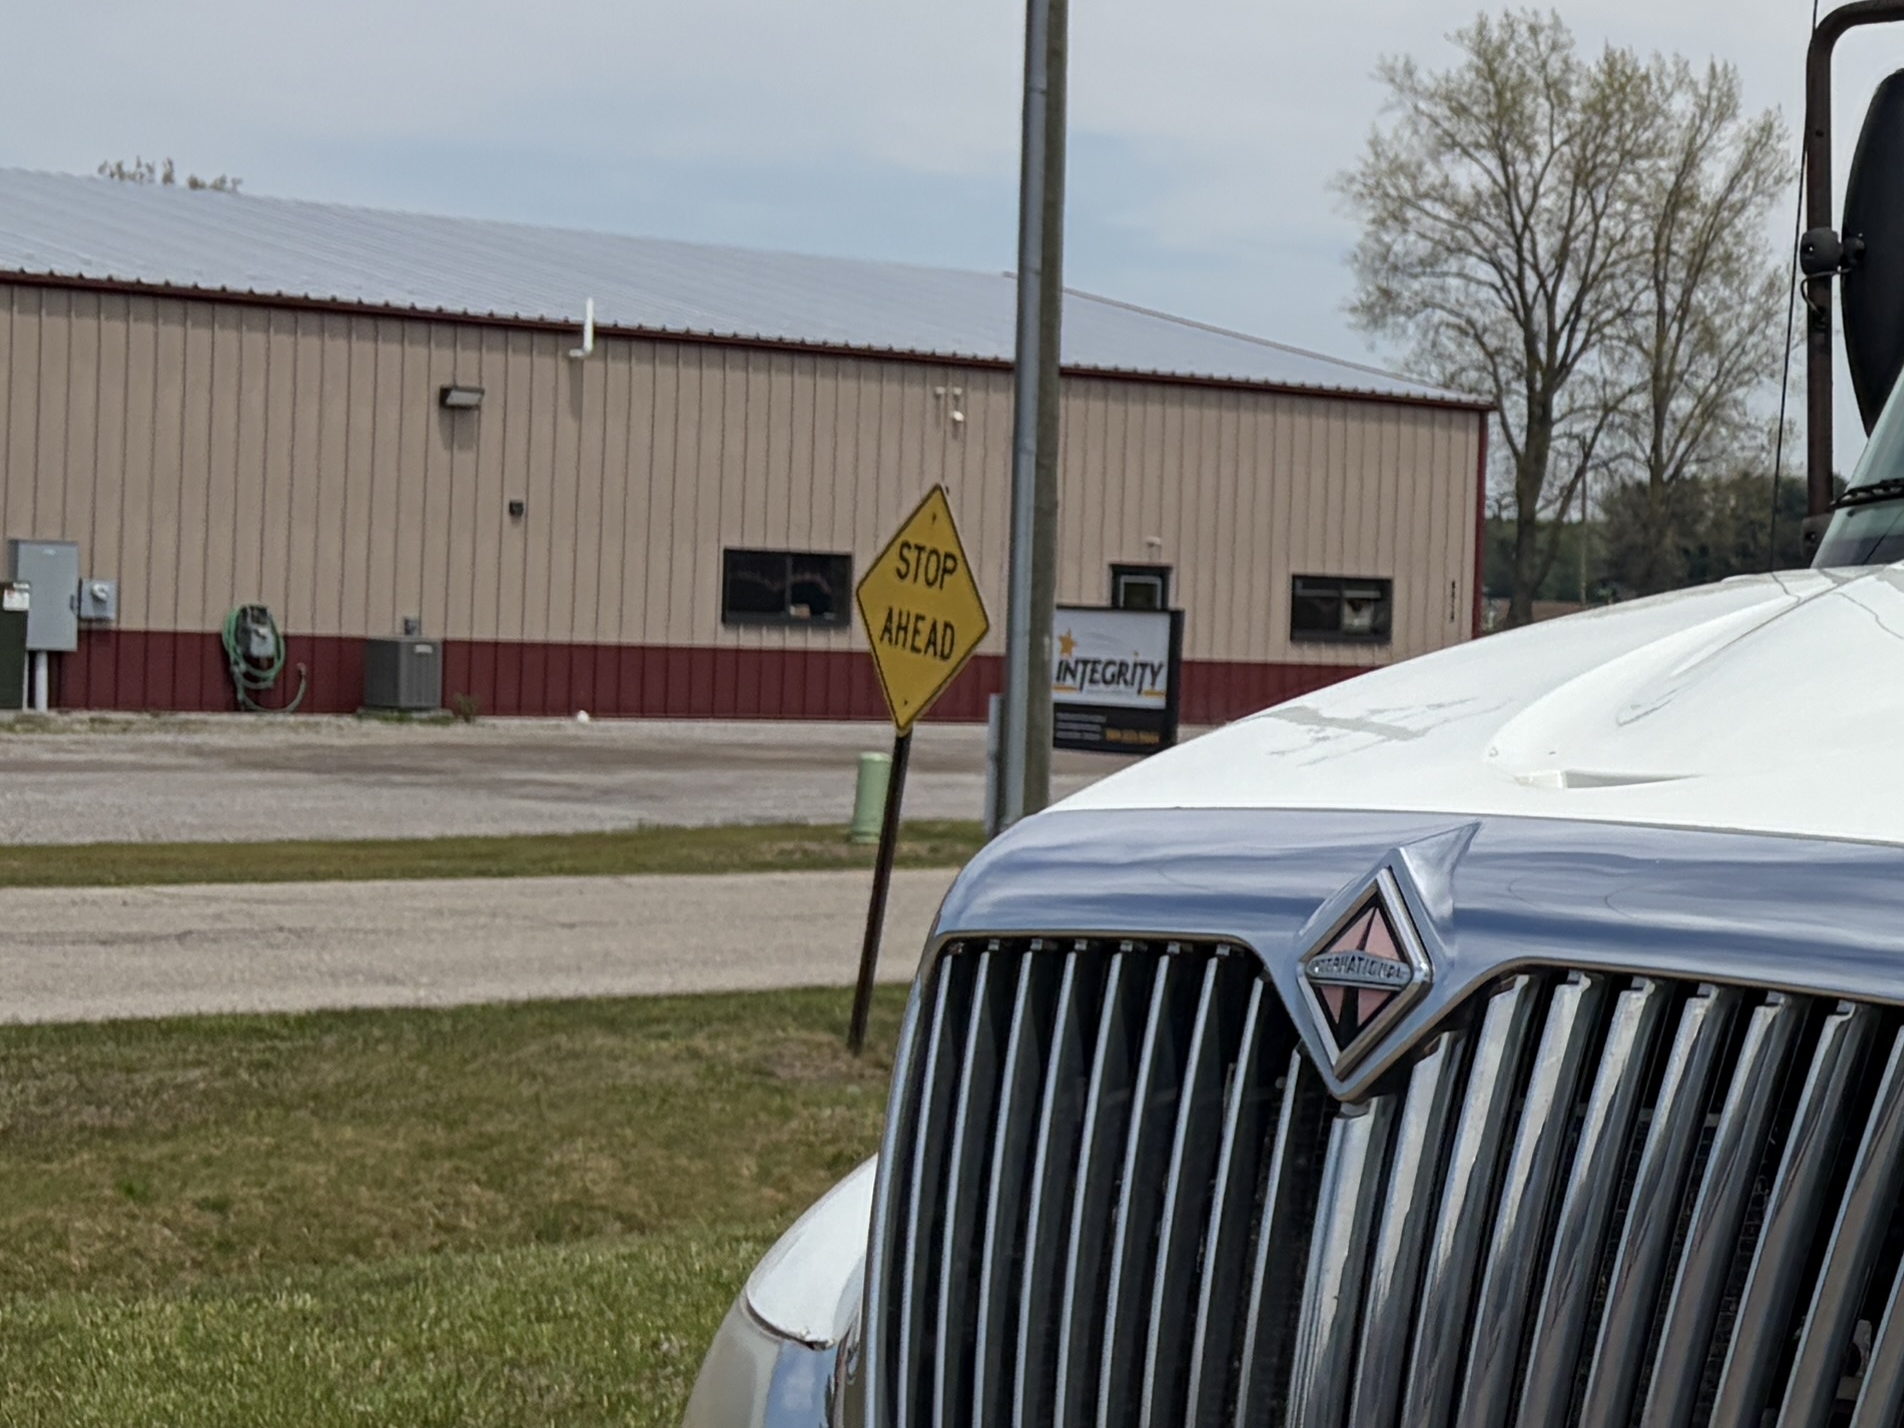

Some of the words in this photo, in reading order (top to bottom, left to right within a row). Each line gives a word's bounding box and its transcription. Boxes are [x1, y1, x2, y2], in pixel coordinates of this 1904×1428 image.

[895, 539, 957, 592] STOP
[879, 605, 955, 662] AHEAD
[1055, 655, 1164, 696] INTEGRITY
